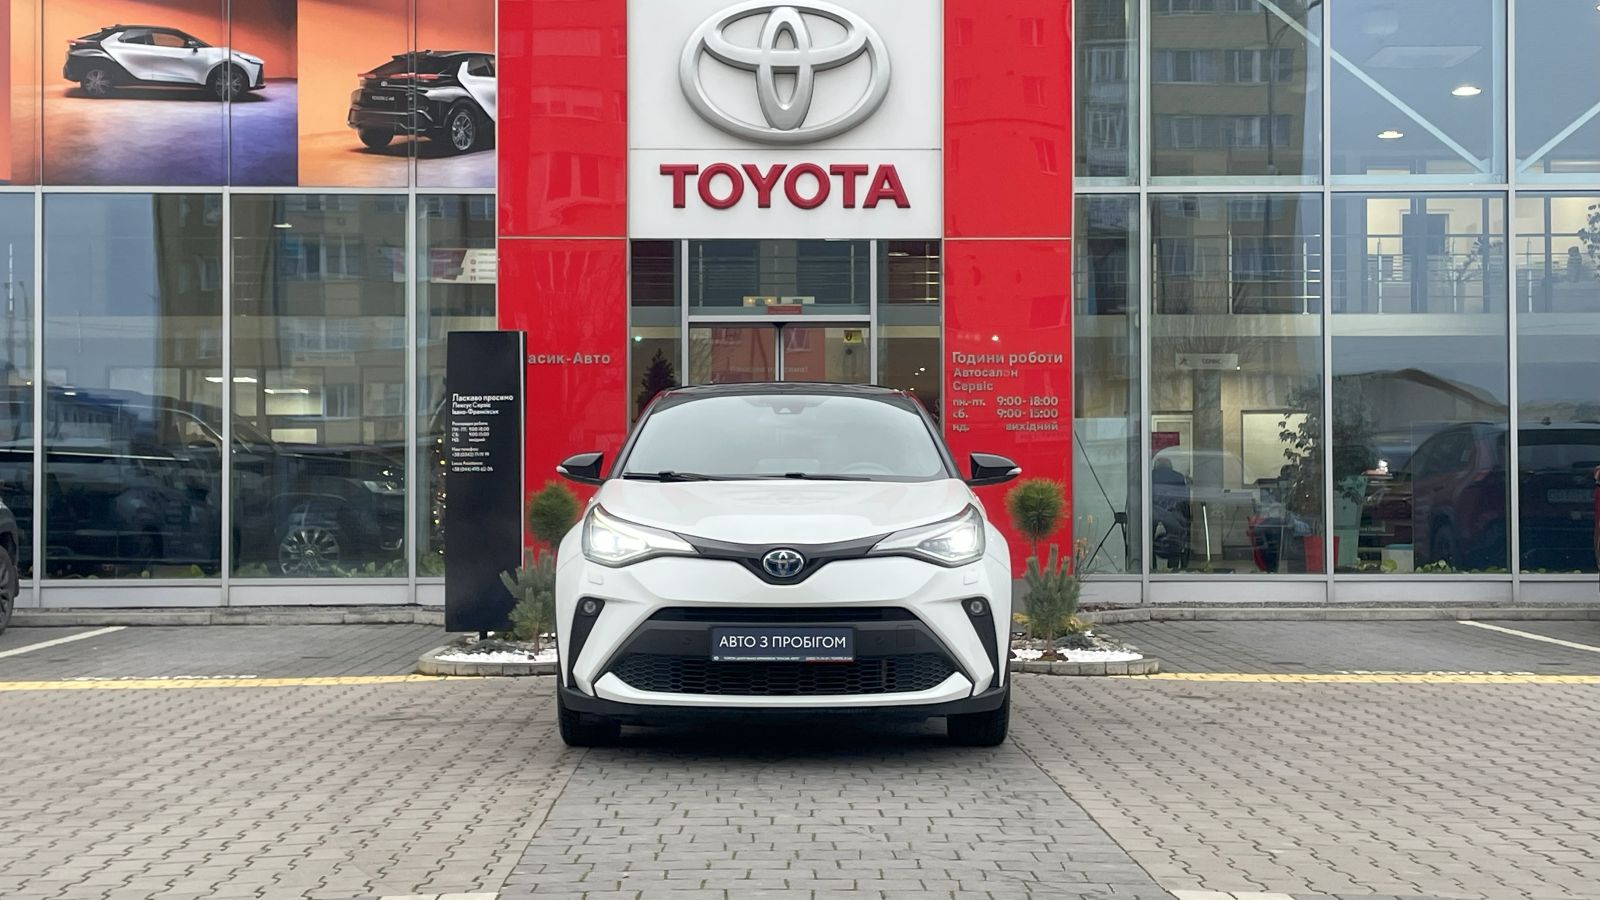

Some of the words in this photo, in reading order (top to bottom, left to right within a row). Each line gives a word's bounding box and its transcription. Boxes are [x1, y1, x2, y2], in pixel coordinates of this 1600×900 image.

[660, 163, 911, 210] TOYOTA
[952, 352, 1004, 365] Години
[1009, 351, 1062, 366] роботи
[952, 381, 994, 393] Сервіс
[452, 394, 482, 402] Ласкаво
[997, 396, 1021, 406] 9:00
[1030, 396, 1058, 406] 18:00
[952, 409, 968, 418] сб.
[997, 408, 1021, 418] 9:00
[952, 424, 970, 432] нд.
[1006, 422, 1058, 432] вихідний
[719, 636, 756, 648] АВТО
[772, 636, 846, 648] ПРОБІГОМ
